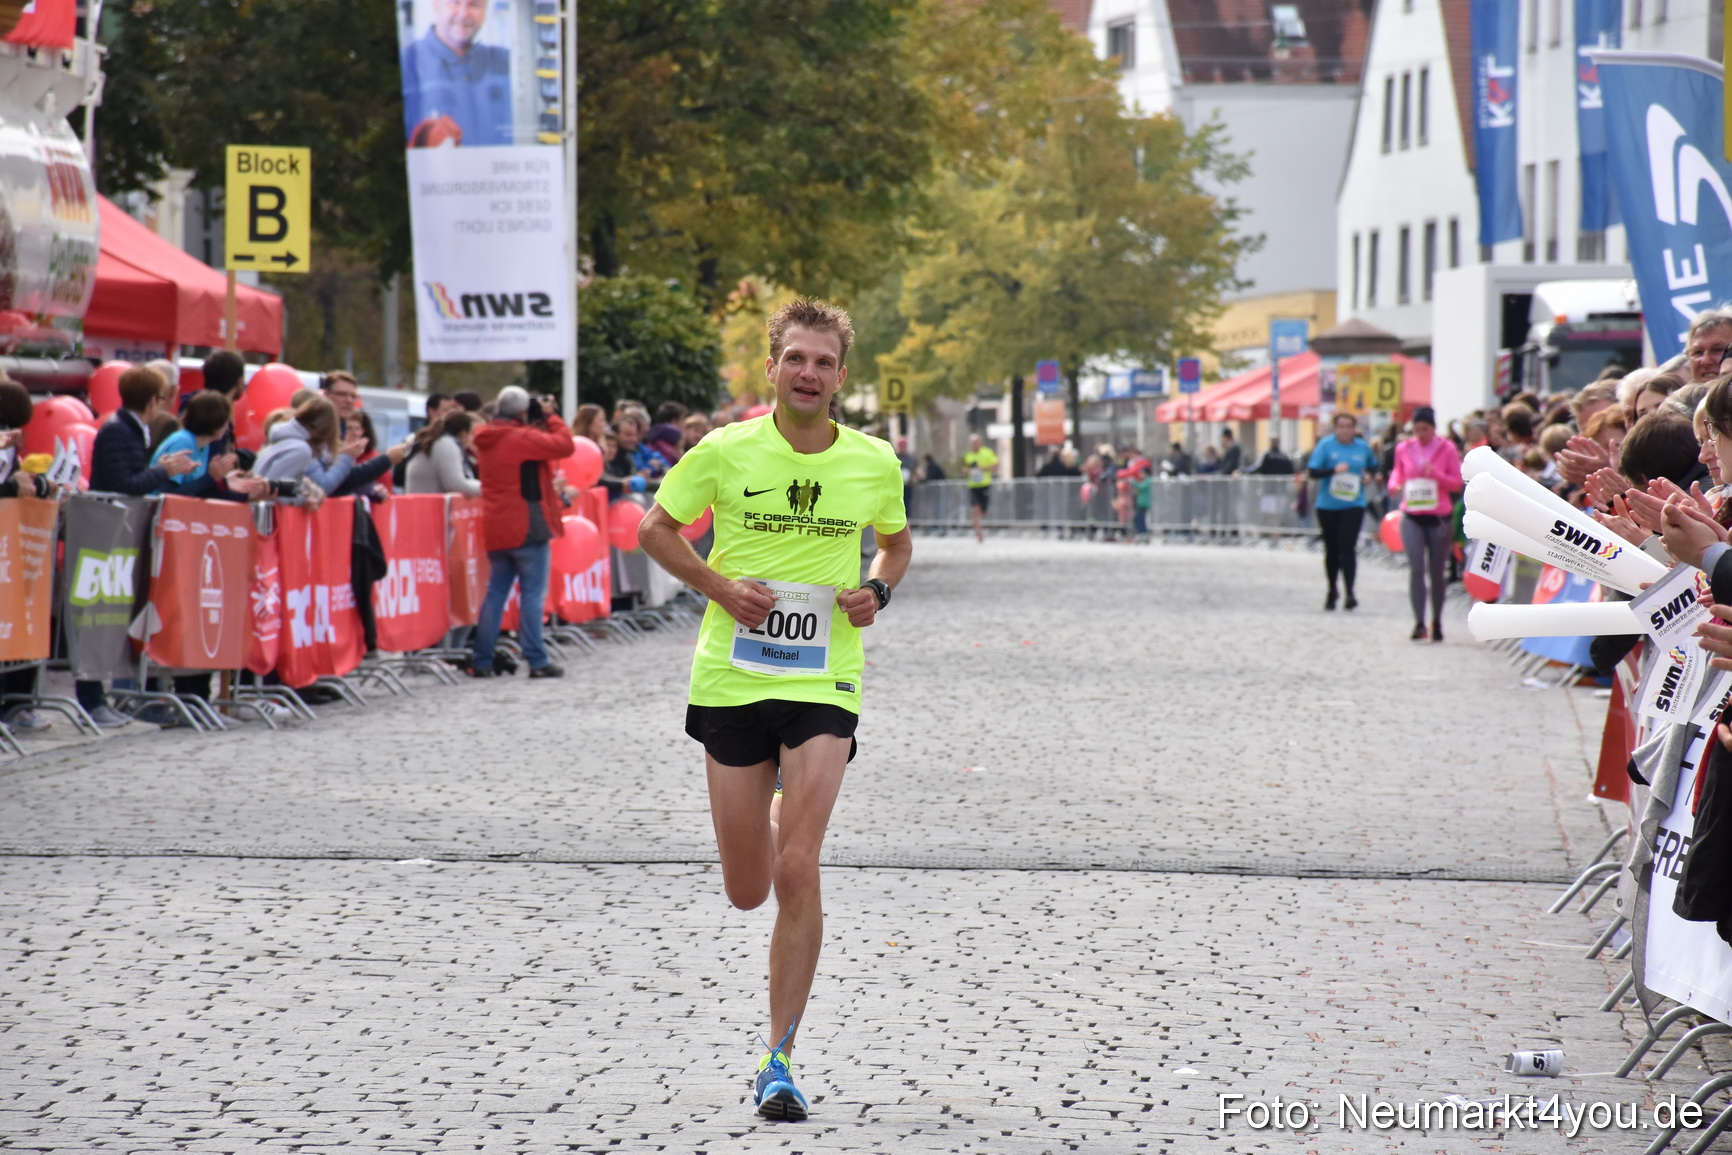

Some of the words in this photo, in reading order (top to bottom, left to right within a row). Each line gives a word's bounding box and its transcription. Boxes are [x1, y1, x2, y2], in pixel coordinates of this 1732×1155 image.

[237, 152, 300, 175] Block
[248, 185, 289, 243] B
[1378, 378, 1396, 401] D
[744, 512, 761, 520] SC
[1544, 534, 1578, 554] stadtwerke
[1577, 547, 1608, 568] neumarkt
[1550, 519, 1602, 555] swn
[1650, 588, 1696, 630] swn
[749, 610, 818, 641] 000
[1658, 614, 1687, 638] stadtwerke
[761, 646, 800, 661] Michael
[1656, 665, 1683, 713] swn
[1709, 684, 1732, 722] sw
